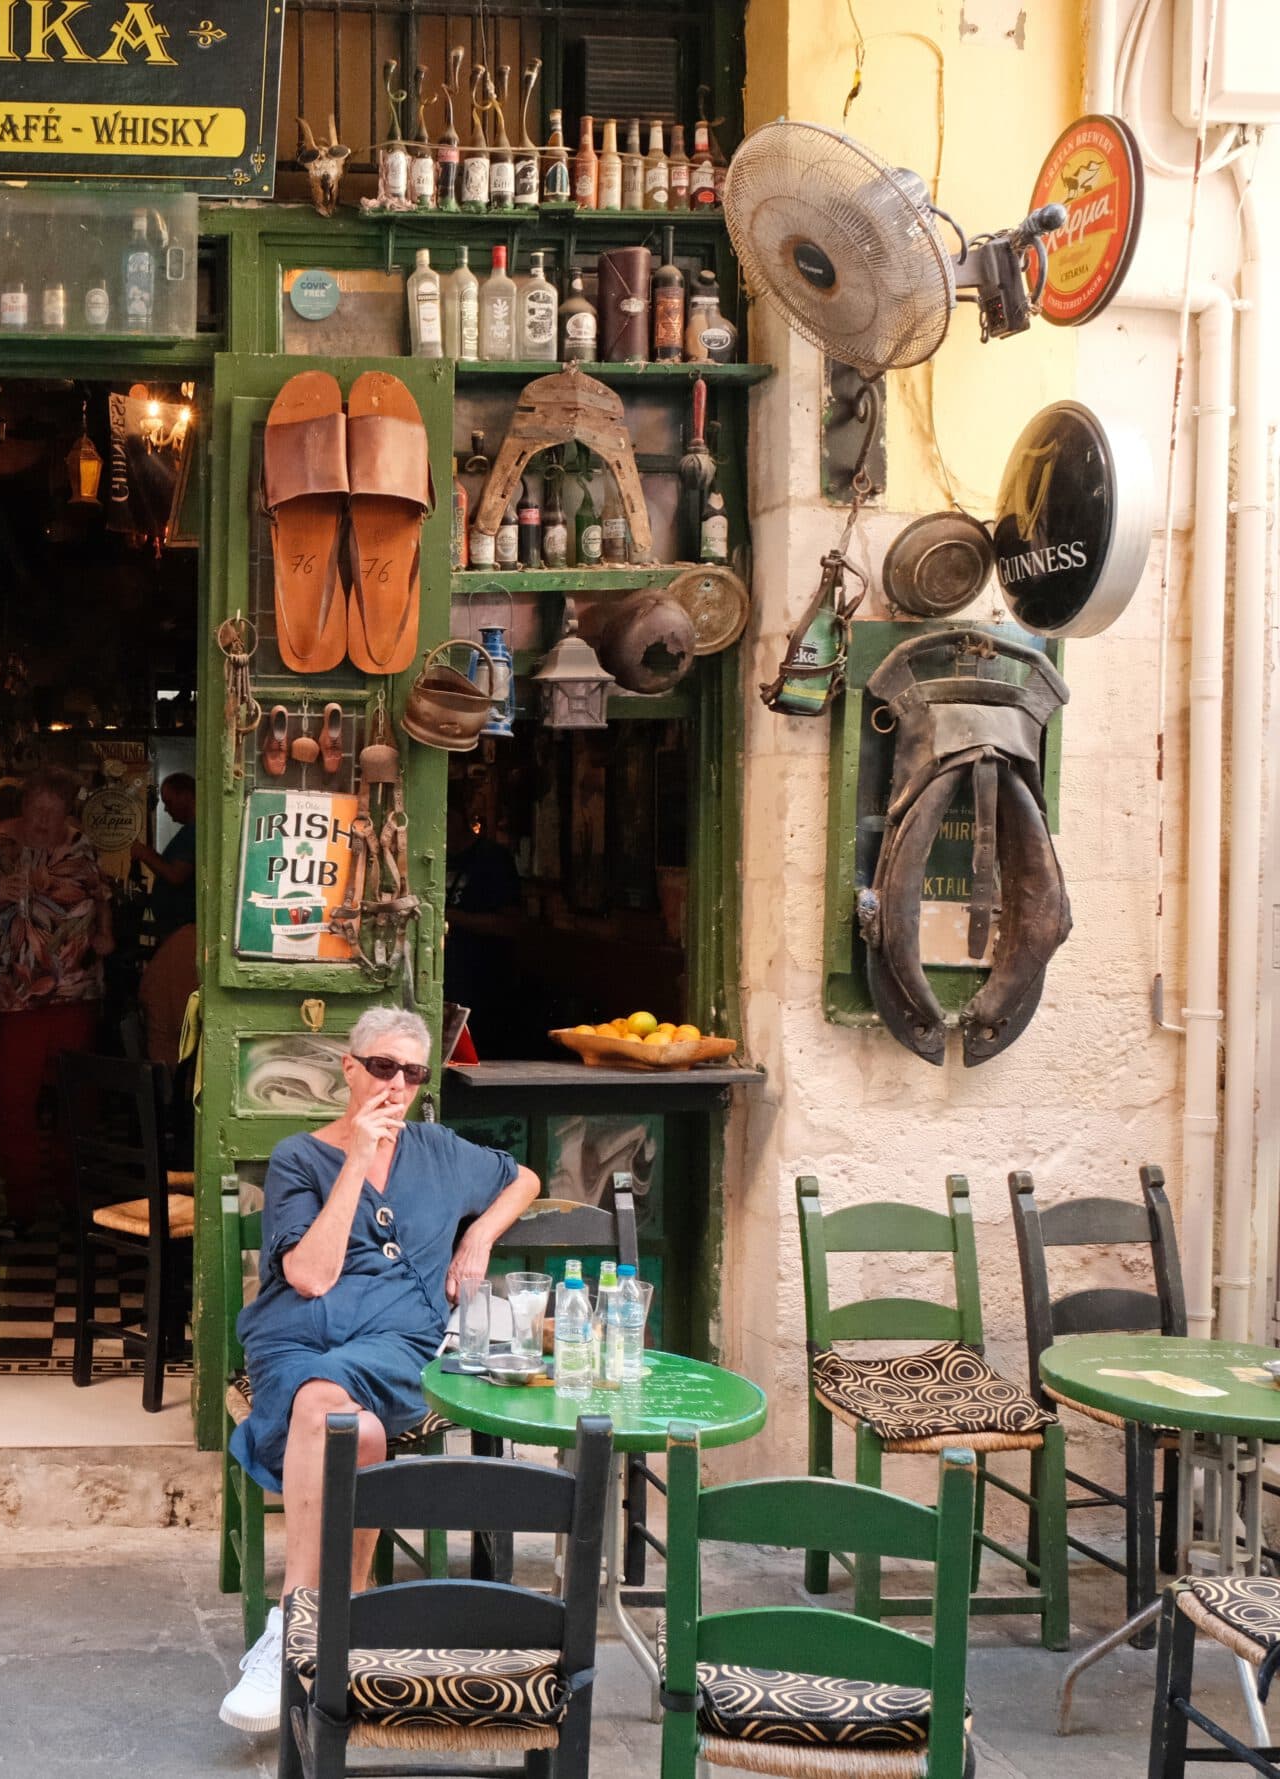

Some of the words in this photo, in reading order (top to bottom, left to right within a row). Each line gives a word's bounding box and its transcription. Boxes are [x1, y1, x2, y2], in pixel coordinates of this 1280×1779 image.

[92, 112, 219, 149] WHISKY
[1044, 144, 1074, 188] CRETAN
[1075, 130, 1114, 155] BREWERY
[290, 554, 317, 575] 76
[361, 557, 383, 583] 76
[999, 541, 1088, 586] GUINNESS
[255, 813, 354, 849] IRISH
[267, 856, 338, 887] PUB
